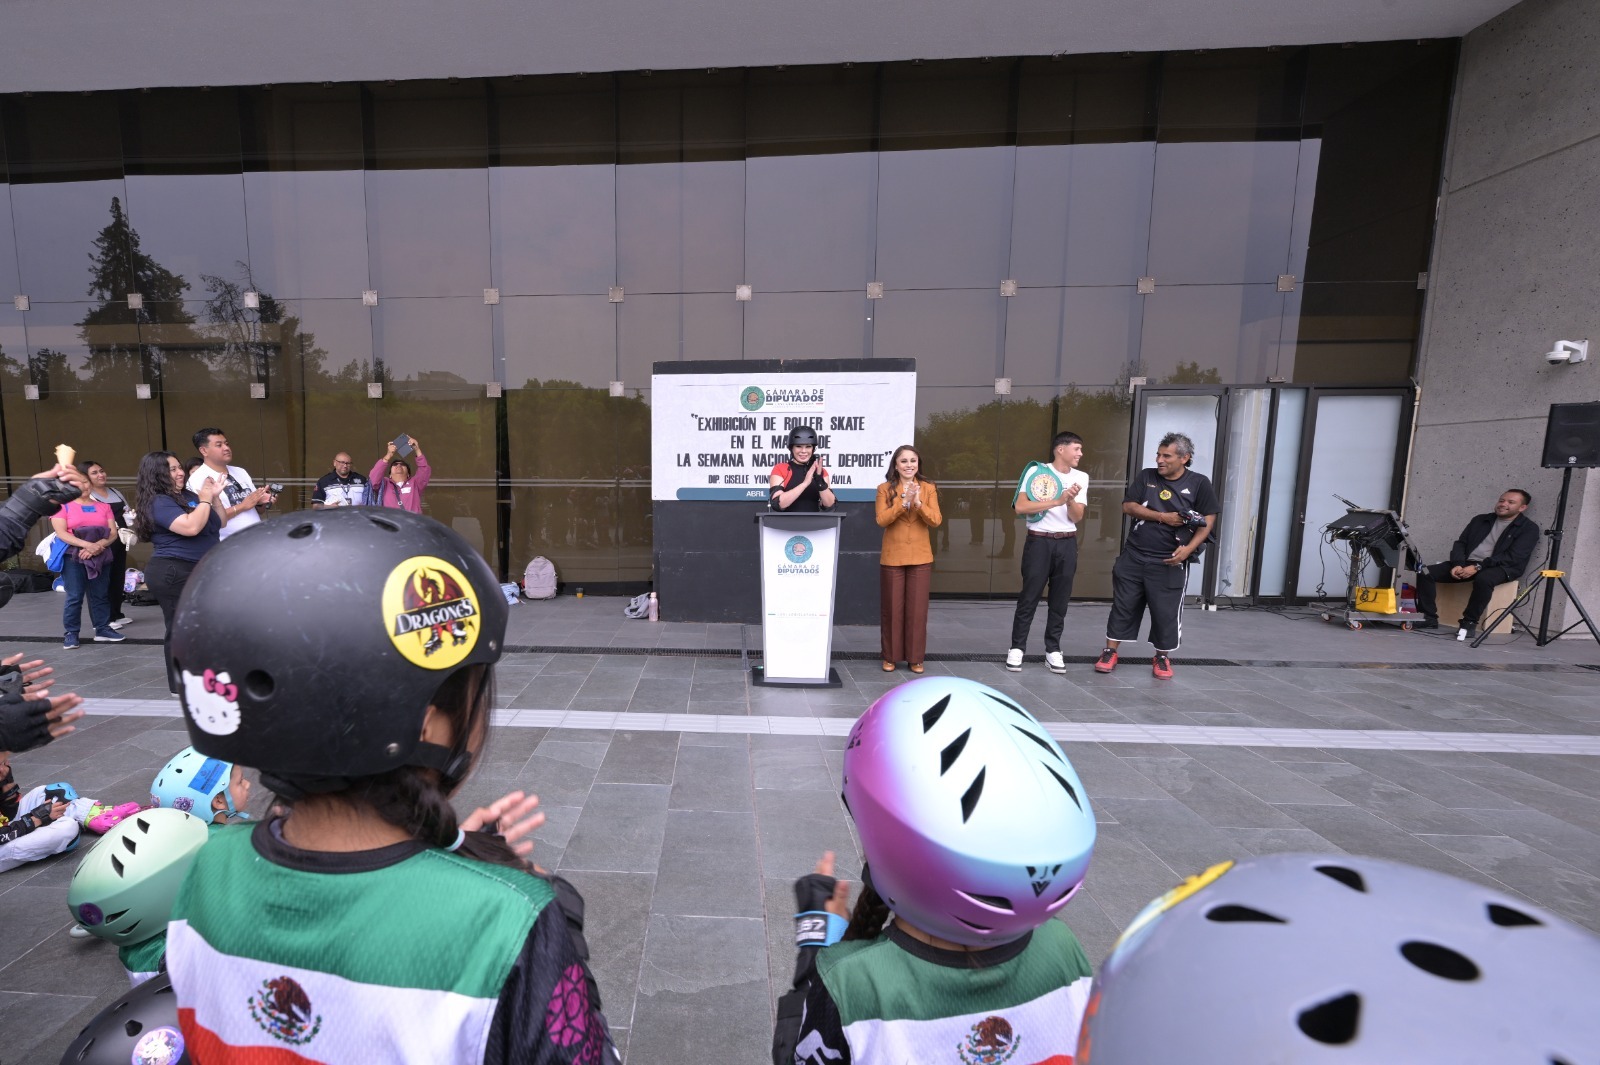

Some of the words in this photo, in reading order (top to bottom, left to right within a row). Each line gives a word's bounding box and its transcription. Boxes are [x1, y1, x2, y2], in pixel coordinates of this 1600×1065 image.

[765, 394, 824, 402] DIPUTADOS
[763, 416, 776, 431] DE
[830, 416, 865, 431] SKATE
[730, 435, 745, 449] EN
[751, 435, 764, 449] EL
[771, 435, 789, 449] MA
[817, 435, 831, 449] DE
[677, 453, 691, 467] LA
[697, 453, 744, 467] SEMANA
[752, 453, 791, 467] NACION
[708, 475, 721, 484] DIP.
[724, 475, 749, 484] GISELLE
[754, 475, 771, 484] YUN
[830, 473, 852, 485] ÁVILA
[396, 598, 474, 634] DRAGONES
